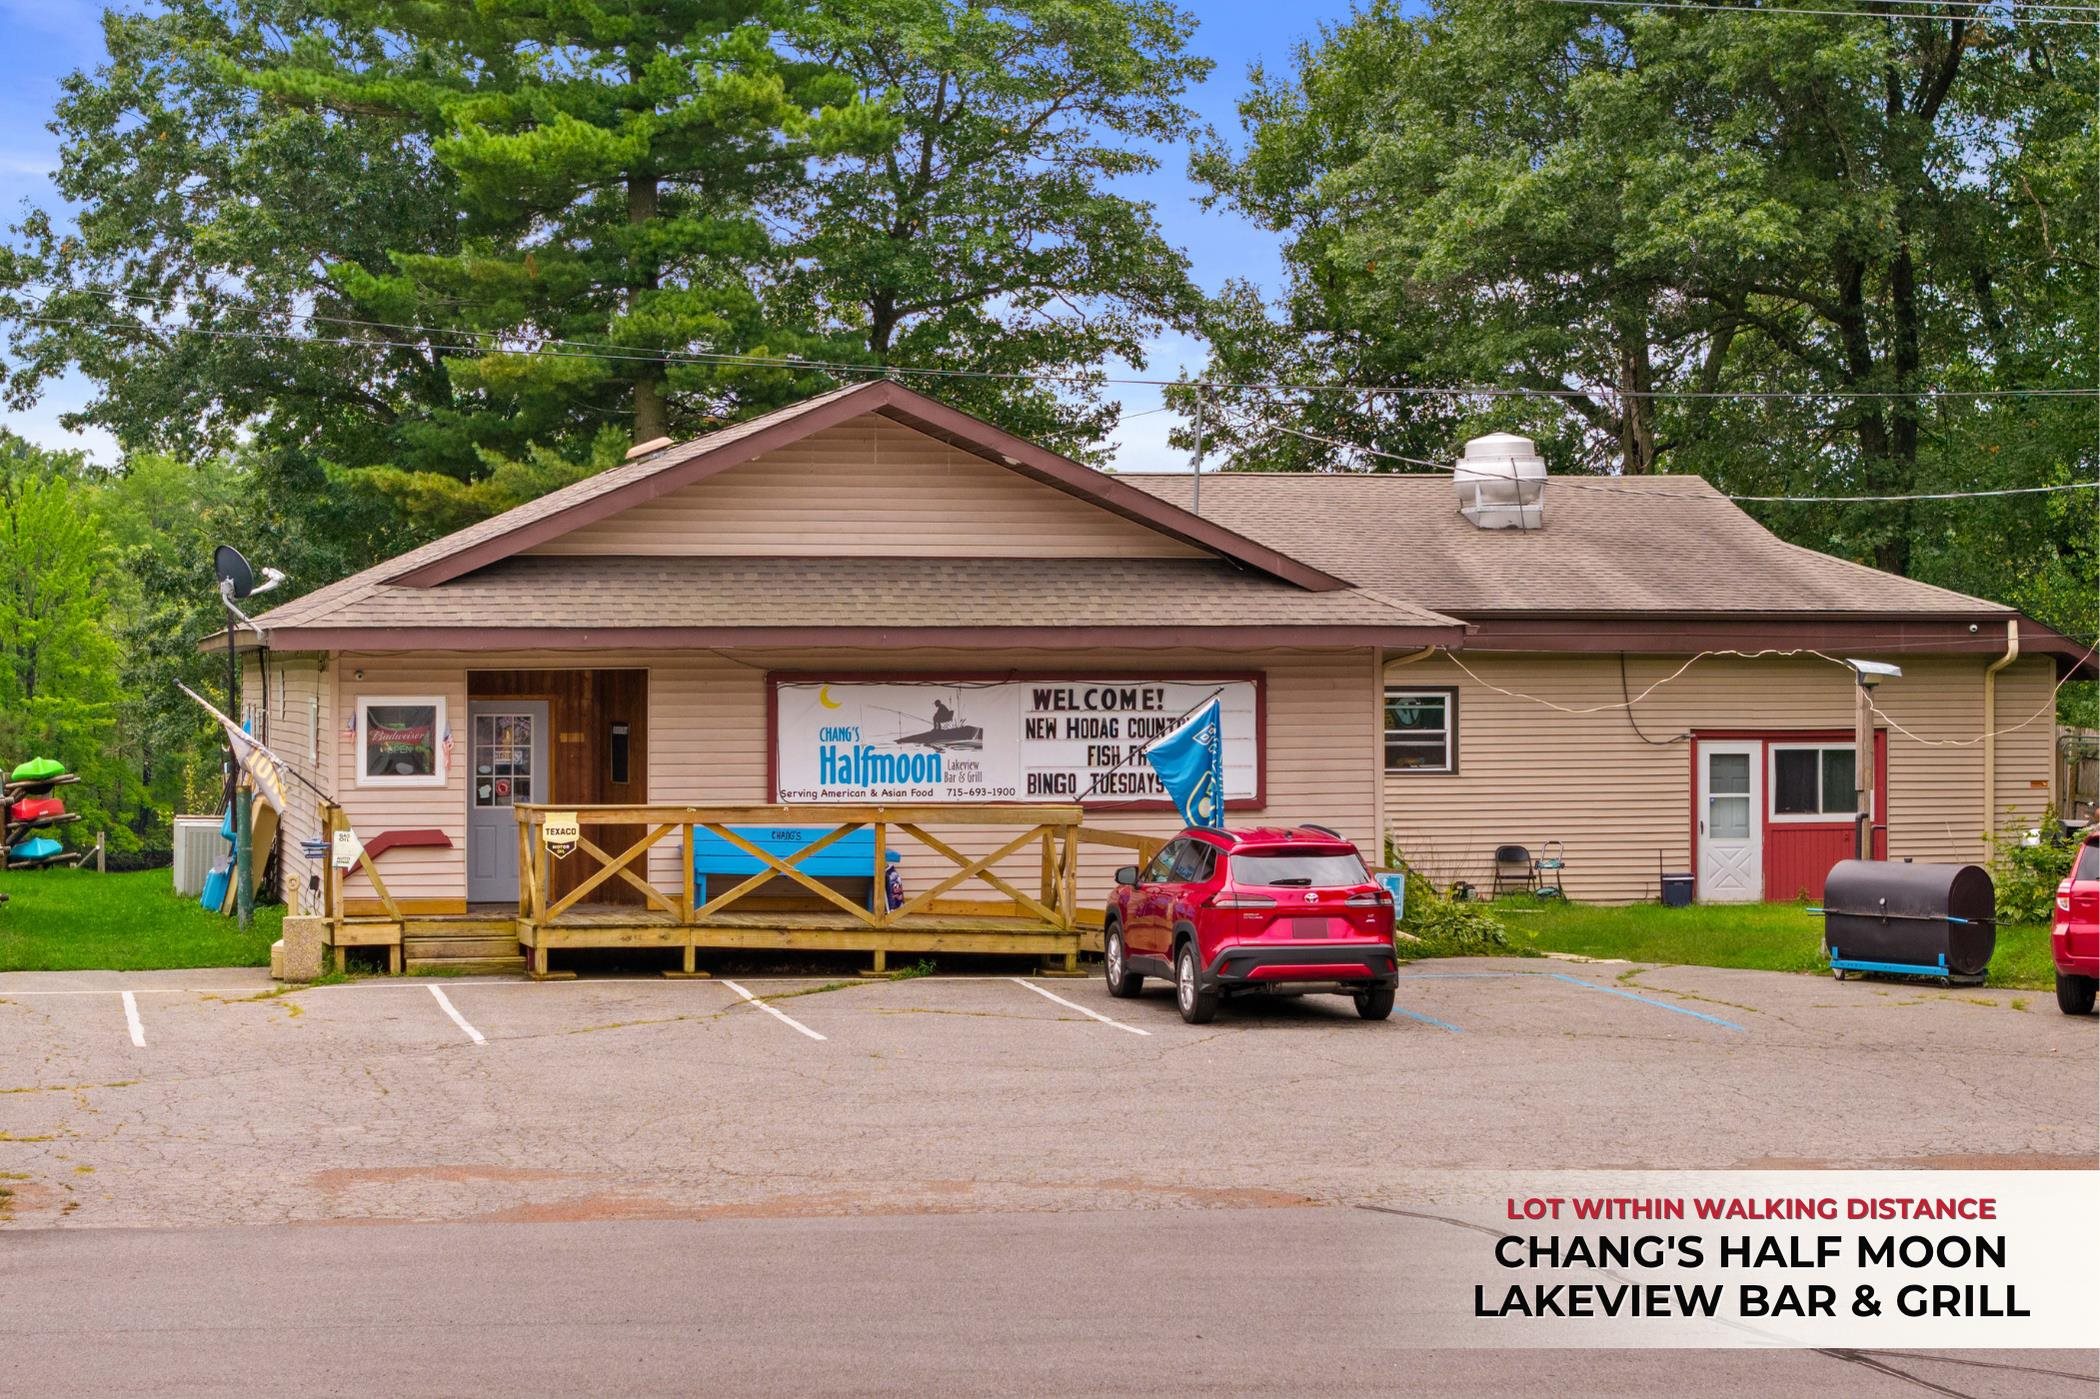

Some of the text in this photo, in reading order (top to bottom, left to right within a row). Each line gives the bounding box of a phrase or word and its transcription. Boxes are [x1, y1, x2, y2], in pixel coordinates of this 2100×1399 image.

[1032, 688, 1165, 711] WELCOME!
[371, 729, 425, 742] Budweiser
[819, 726, 861, 743] CHANG'S
[1025, 717, 1190, 739] NEW HODAG COUNT
[1087, 744, 1149, 767] FISH FR
[819, 744, 943, 788] Halfmoon
[947, 759, 980, 771] Lakeview
[943, 771, 983, 783] Bar & Grill
[1027, 772, 1165, 795] BINGO TUESDAYS
[780, 787, 1017, 801] Serving American & Asian Food 715-693-1900
[545, 827, 578, 836] TEXACO
